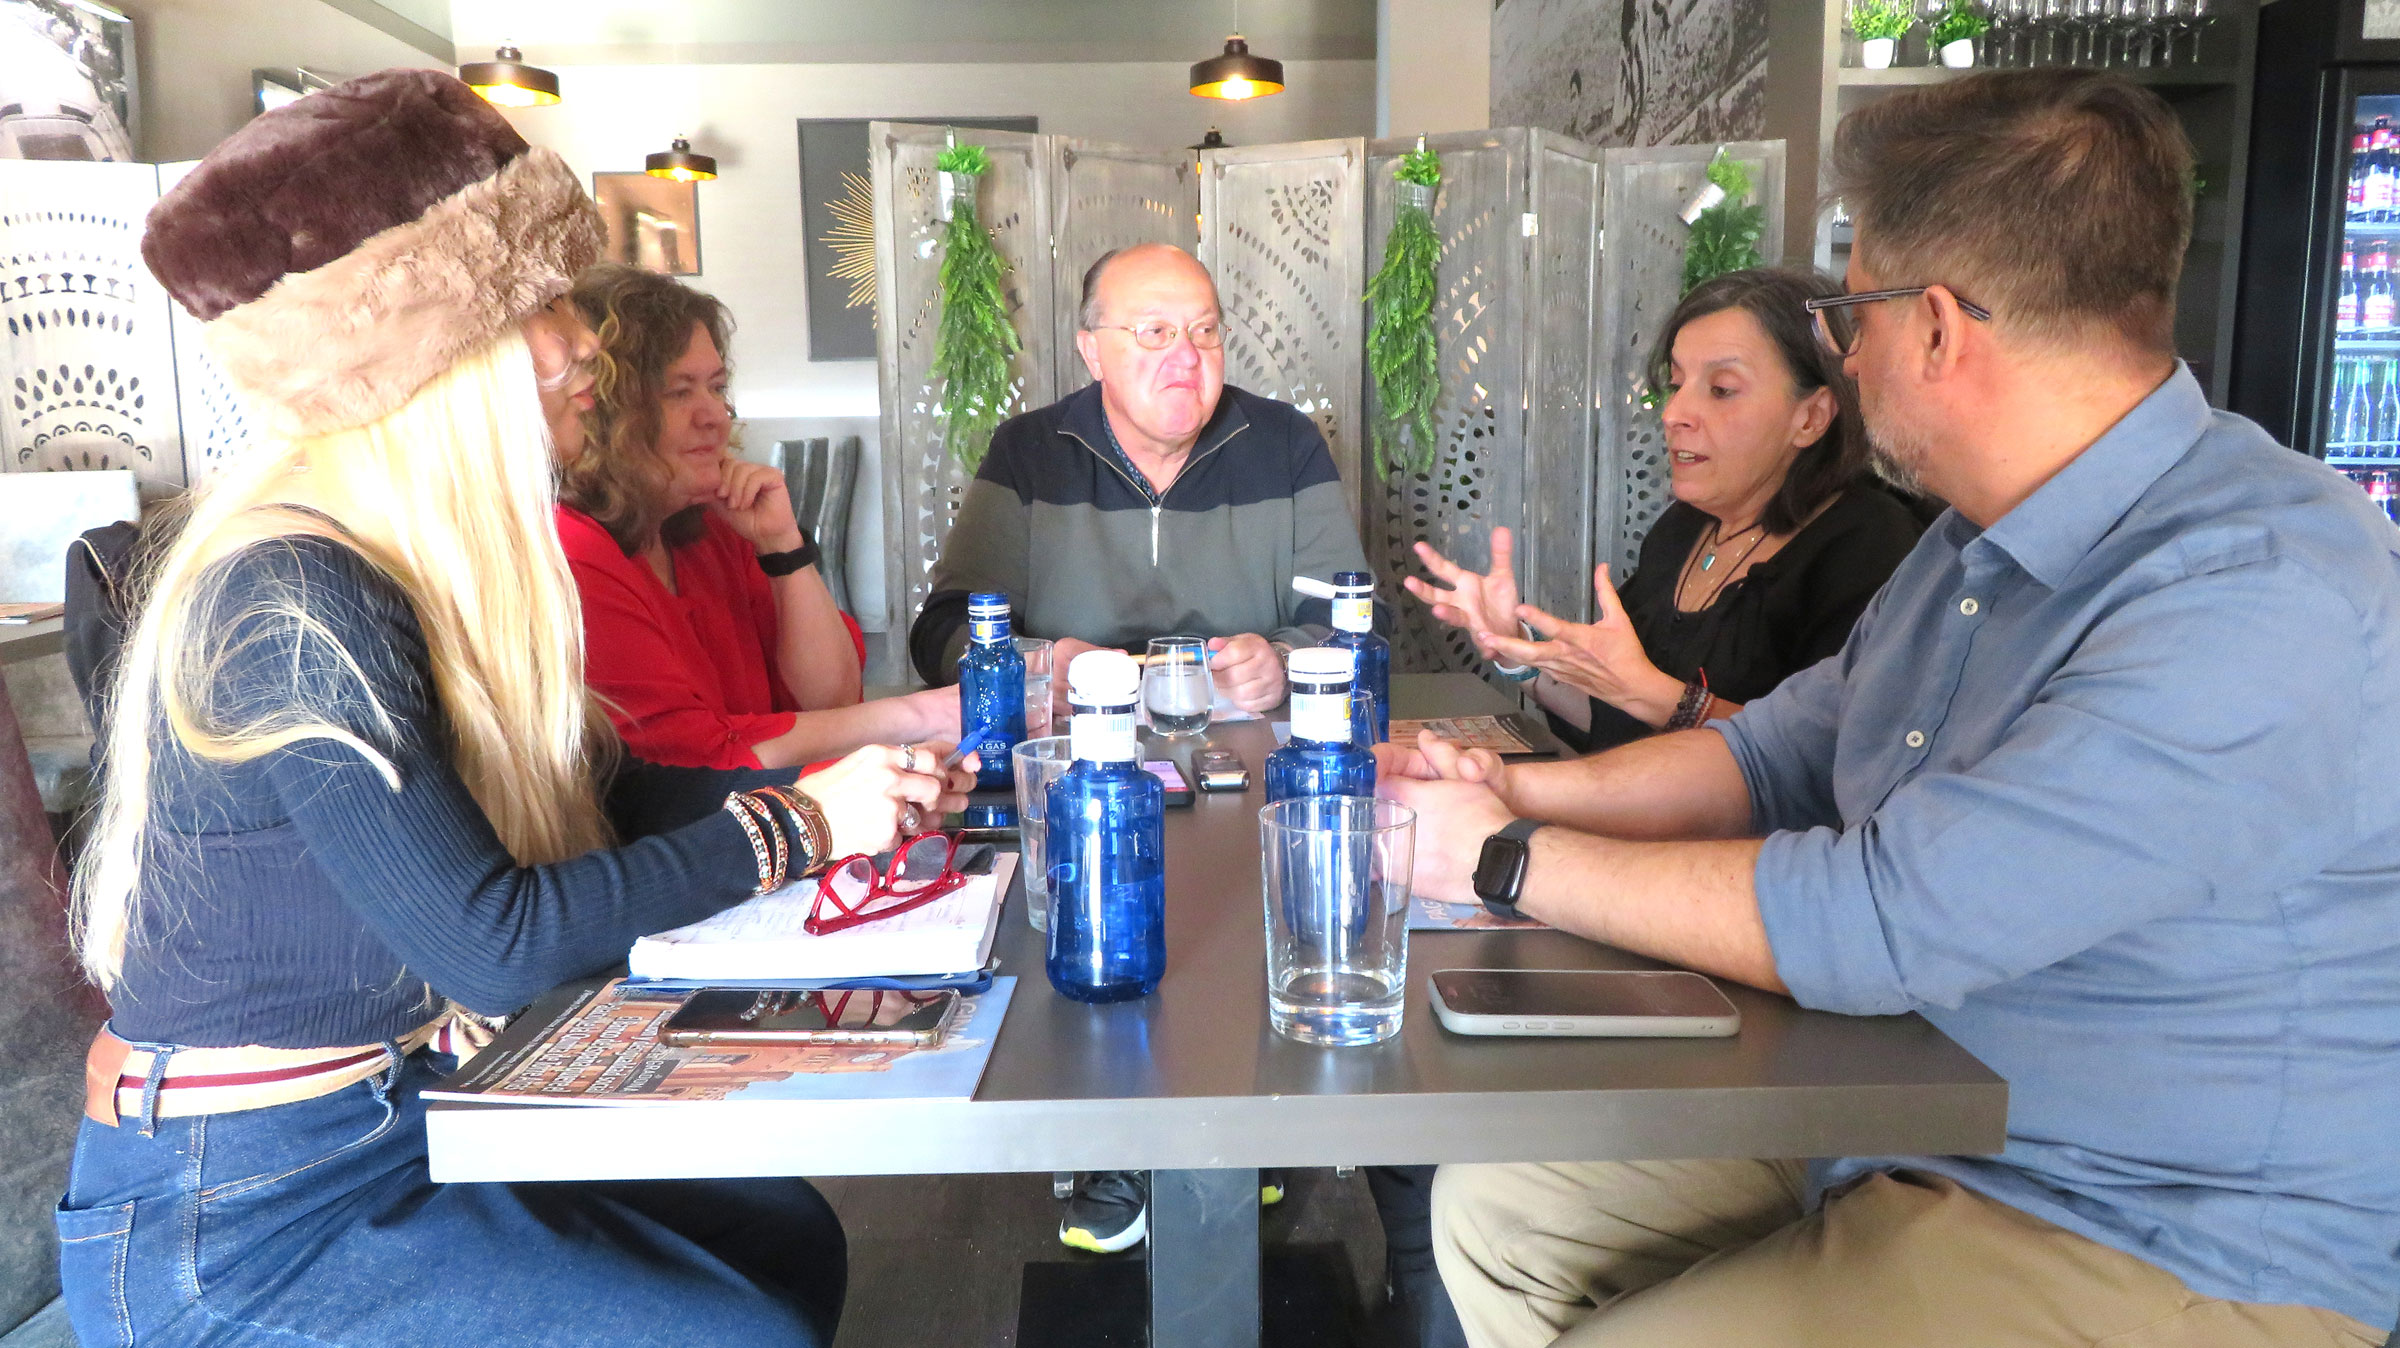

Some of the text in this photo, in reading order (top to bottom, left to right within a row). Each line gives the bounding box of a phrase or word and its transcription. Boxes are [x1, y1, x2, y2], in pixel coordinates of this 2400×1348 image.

[985, 742, 1007, 750] GAS
[621, 1060, 665, 1091] GRADONA
[582, 1076, 622, 1093] social
